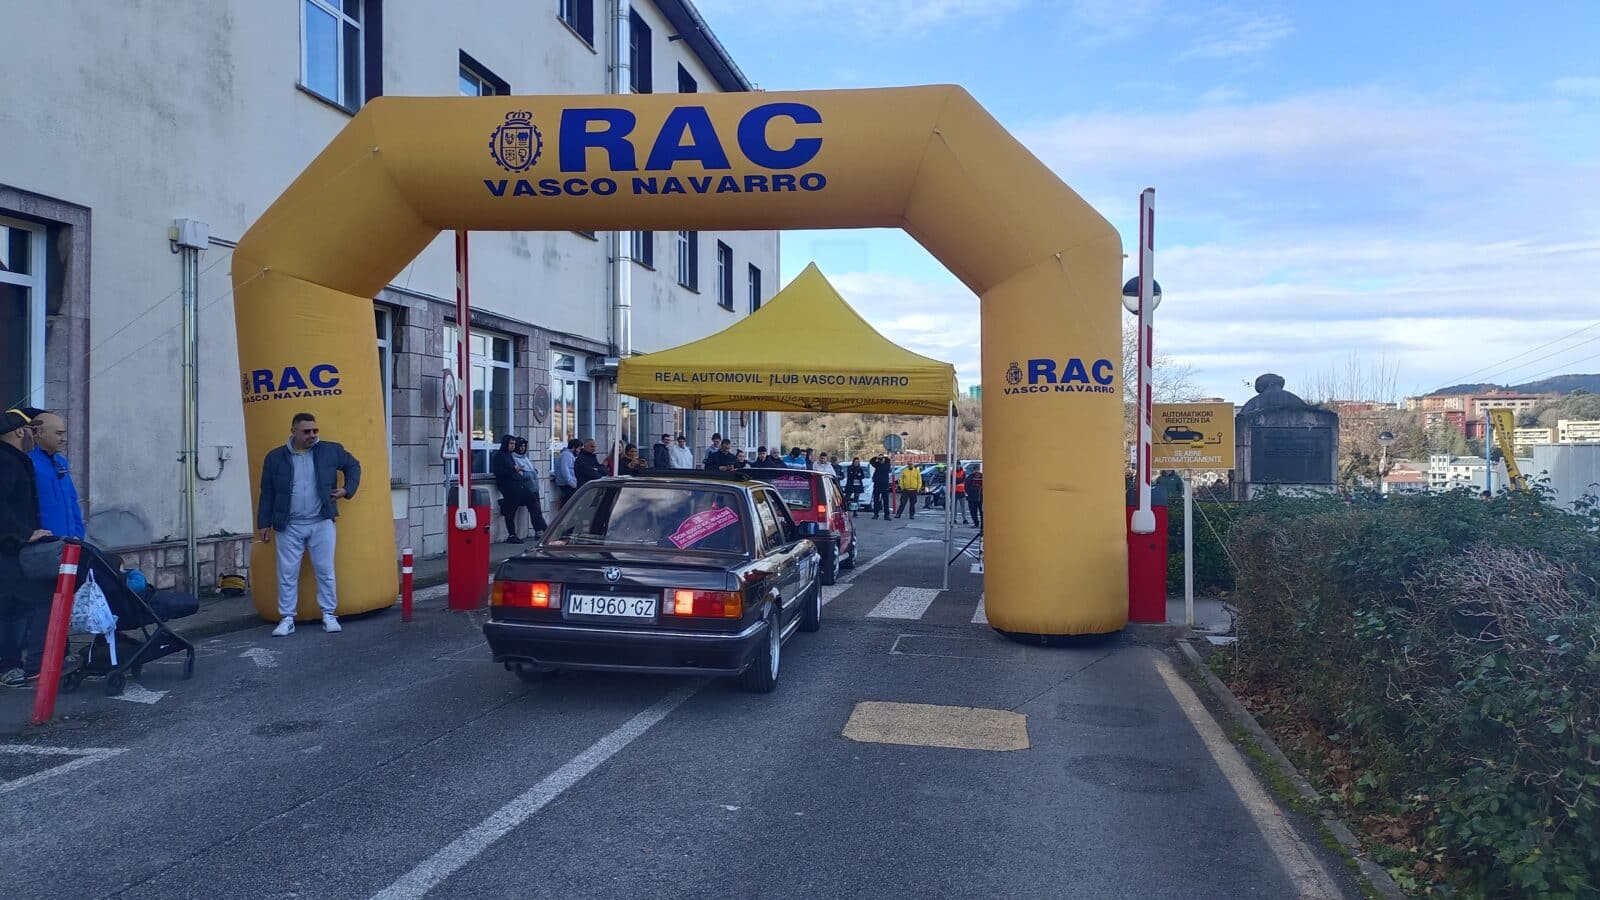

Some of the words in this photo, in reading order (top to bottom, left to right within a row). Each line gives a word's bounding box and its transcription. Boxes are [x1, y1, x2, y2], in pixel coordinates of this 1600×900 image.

[559, 102, 823, 172] RAC
[484, 178, 618, 197] VASCO
[632, 173, 827, 195] NAVARRO
[252, 364, 340, 393] RAC
[655, 372, 689, 382] REAL
[691, 372, 762, 383] AUTOMOVIL
[769, 373, 799, 386] LUB
[803, 375, 845, 385] VASCO
[849, 376, 909, 386] NAVARRO
[1027, 358, 1114, 385] RAC
[274, 389, 342, 400] NAVARRO
[1004, 386, 1050, 395] VASCO
[1055, 385, 1115, 394] NAVARRO
